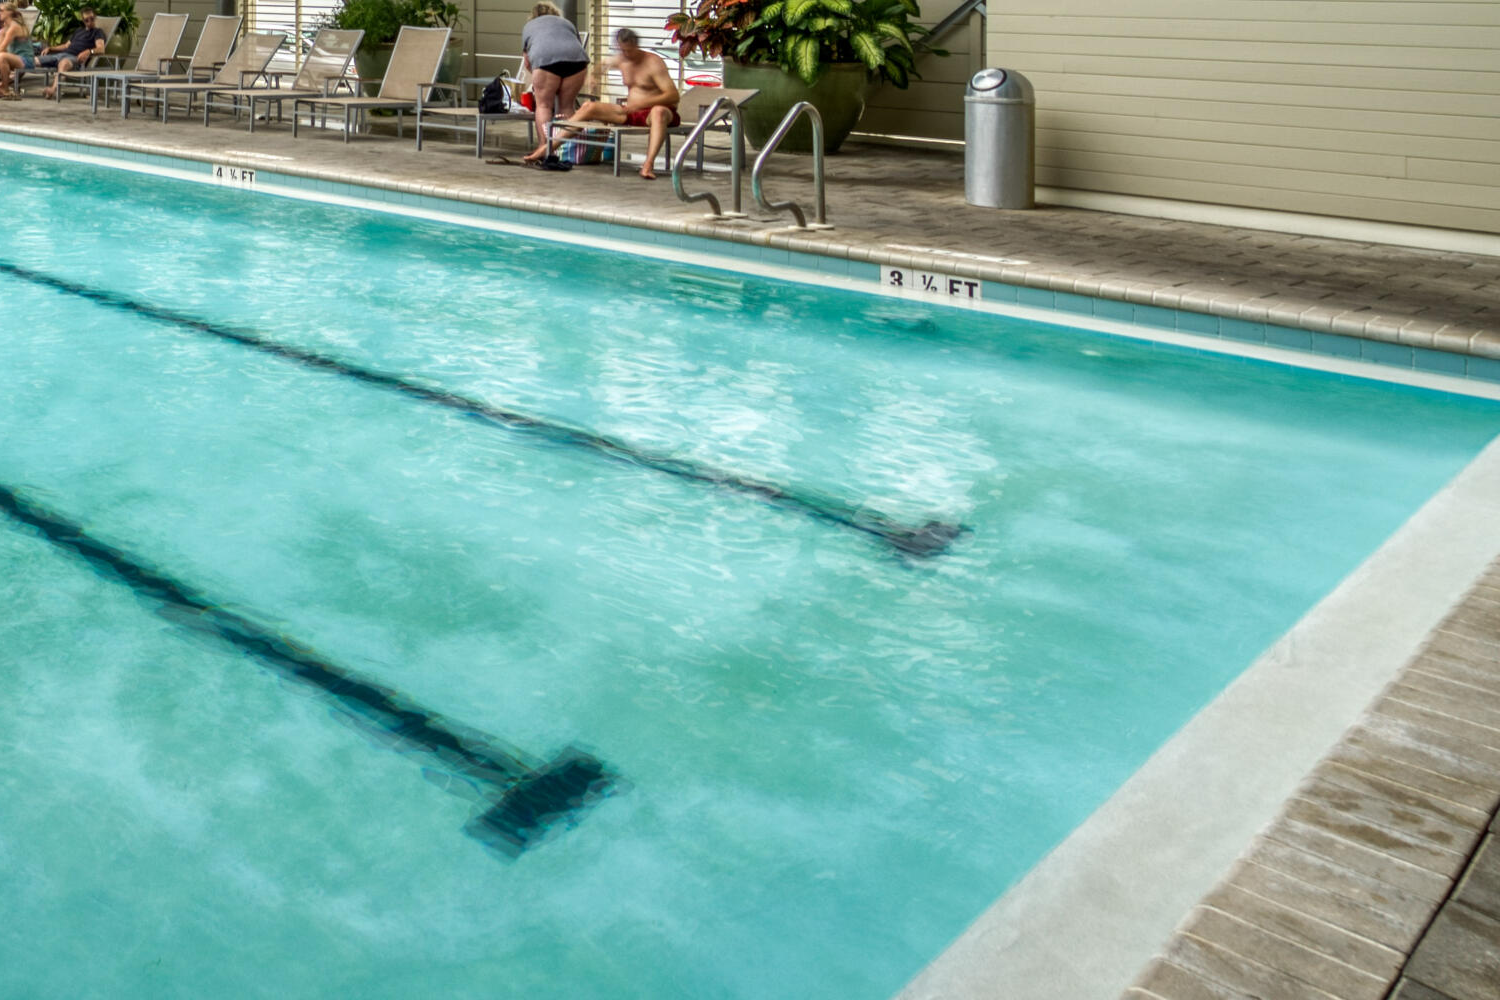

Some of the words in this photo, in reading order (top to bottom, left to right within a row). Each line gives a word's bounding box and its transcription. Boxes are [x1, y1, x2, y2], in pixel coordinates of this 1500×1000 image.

[216, 167, 223, 177] 4
[242, 170, 255, 182] FT
[890, 270, 903, 286] 3
[949, 279, 978, 298] FT
